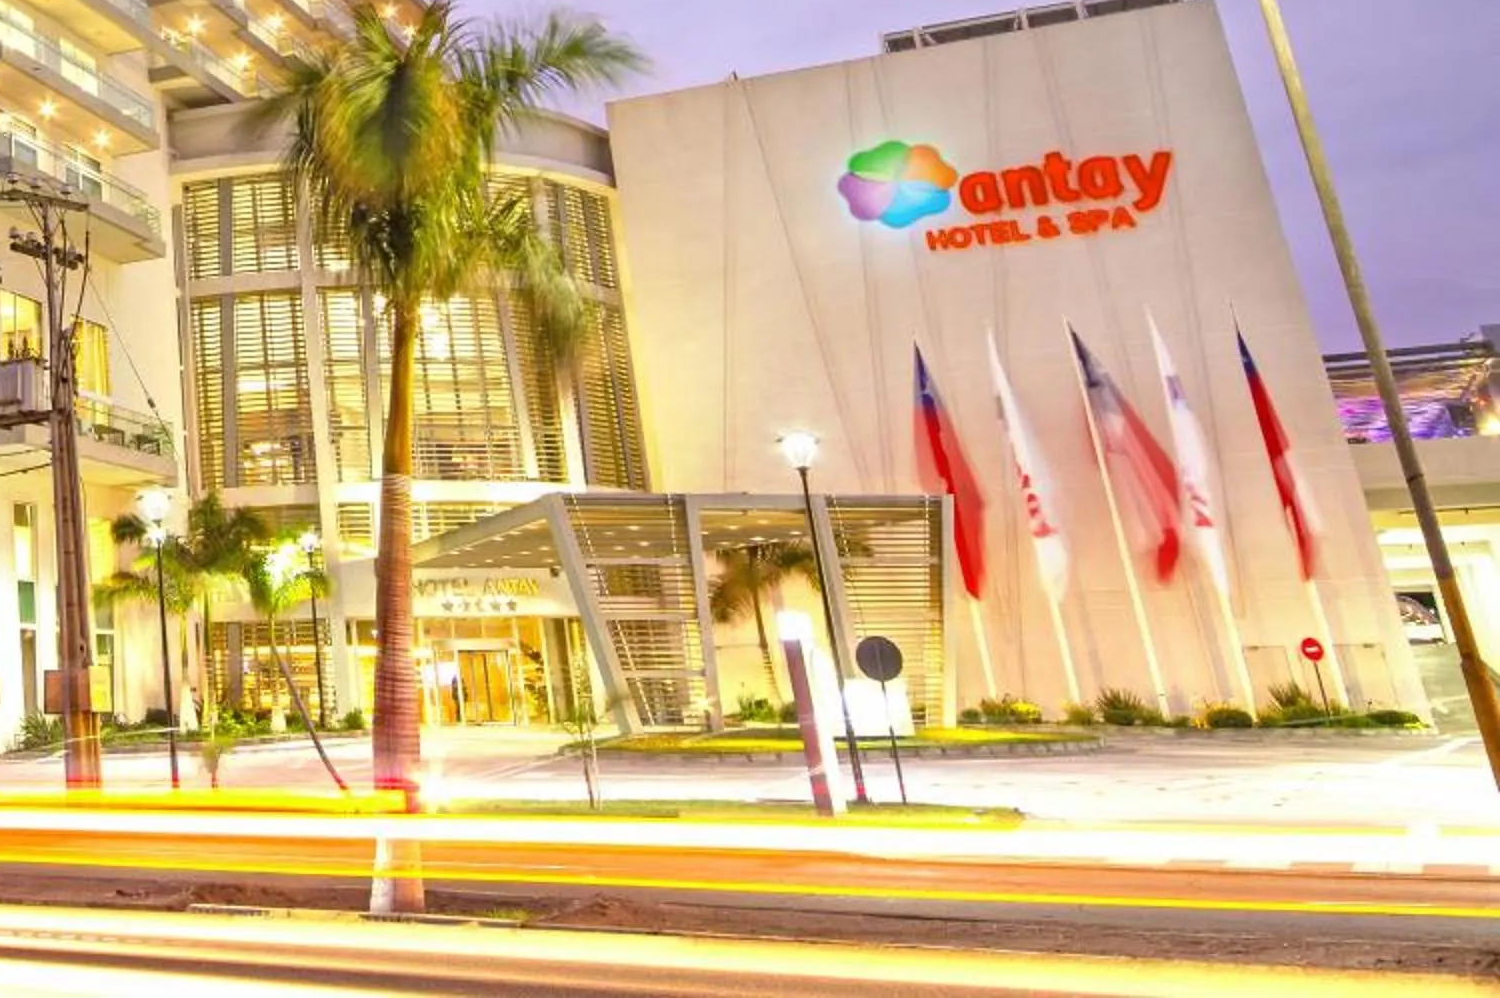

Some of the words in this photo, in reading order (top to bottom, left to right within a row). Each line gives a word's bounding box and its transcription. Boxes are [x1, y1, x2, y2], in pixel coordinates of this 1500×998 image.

[959, 151, 1172, 214] antay
[926, 219, 1030, 251] HOTEL
[1037, 215, 1061, 239] &
[1066, 206, 1137, 235] SPA
